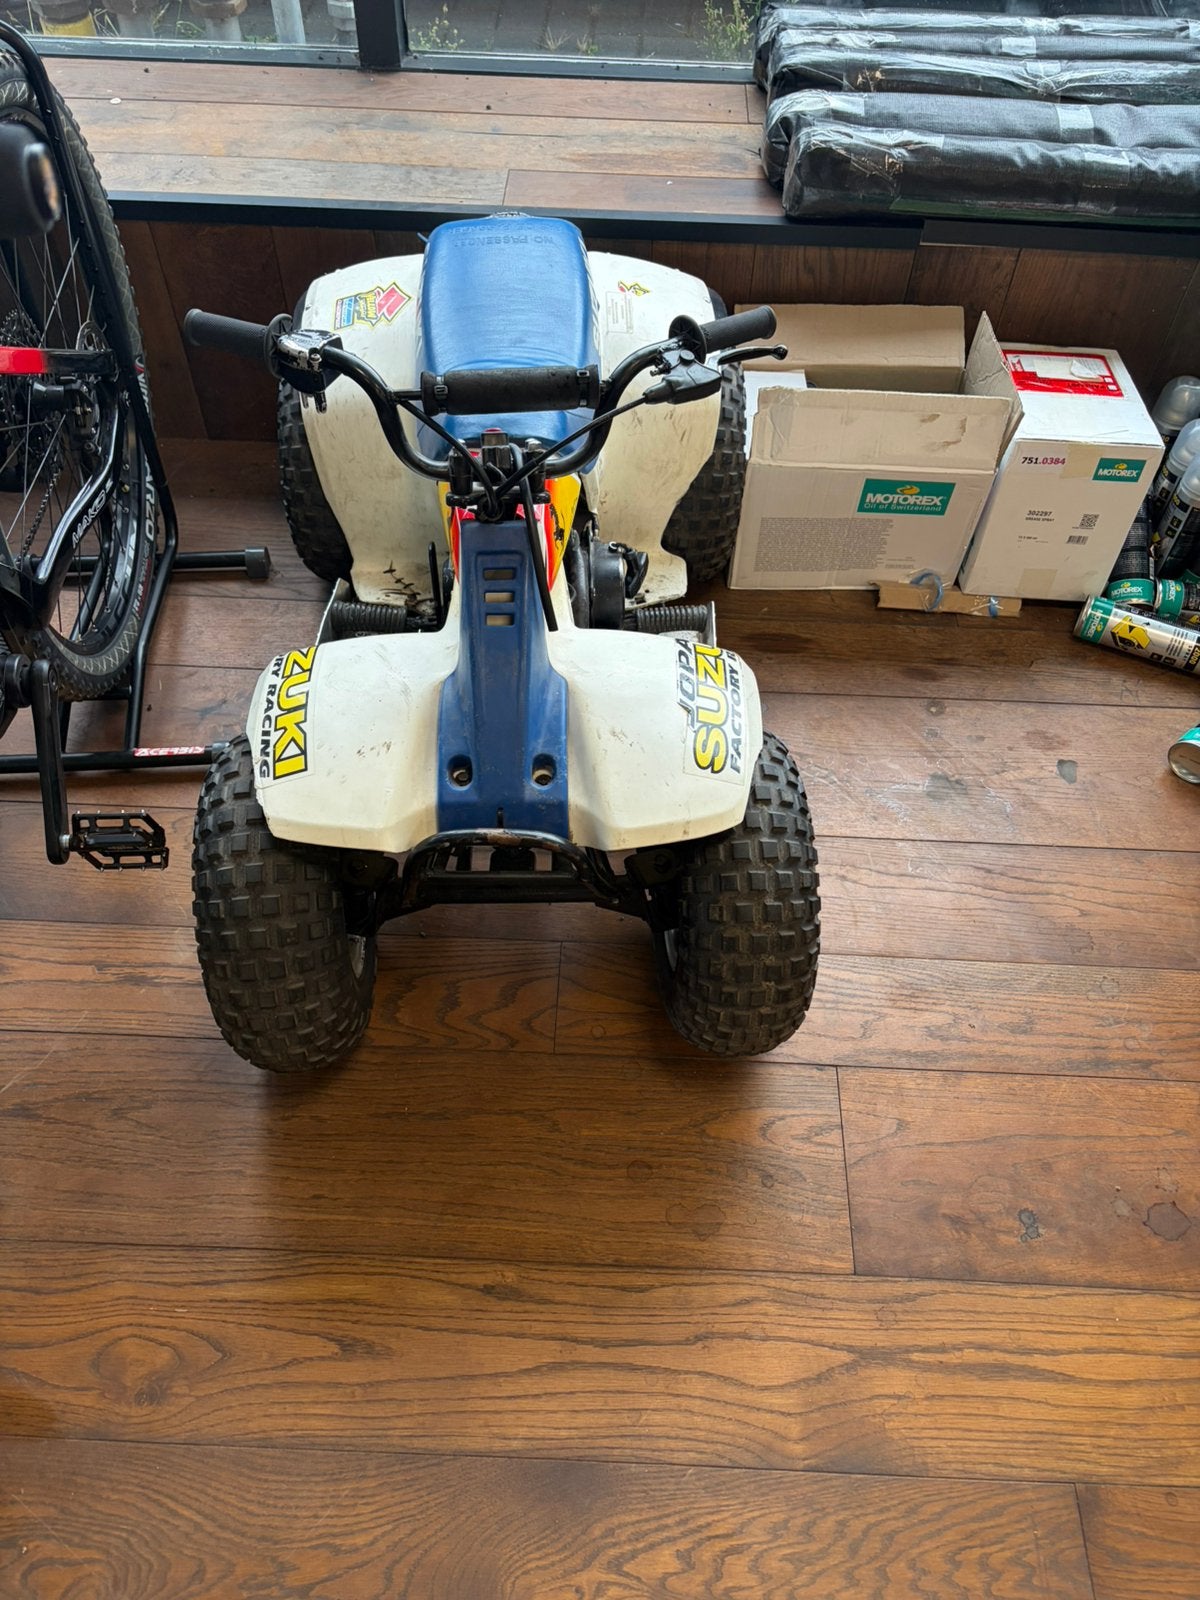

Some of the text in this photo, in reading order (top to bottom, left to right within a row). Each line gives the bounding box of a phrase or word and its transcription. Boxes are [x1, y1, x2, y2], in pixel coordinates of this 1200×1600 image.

[1021, 456, 1066, 465] 751.0384
[1097, 468, 1140, 478] MOTOREX
[865, 493, 944, 506] MOTOREX
[890, 504, 942, 512] Switzerland
[1111, 586, 1144, 597] MOTOREX
[728, 663, 742, 774] FACTORY
[260, 684, 277, 779] RACING
[134, 746, 204, 757] ACERBIS
